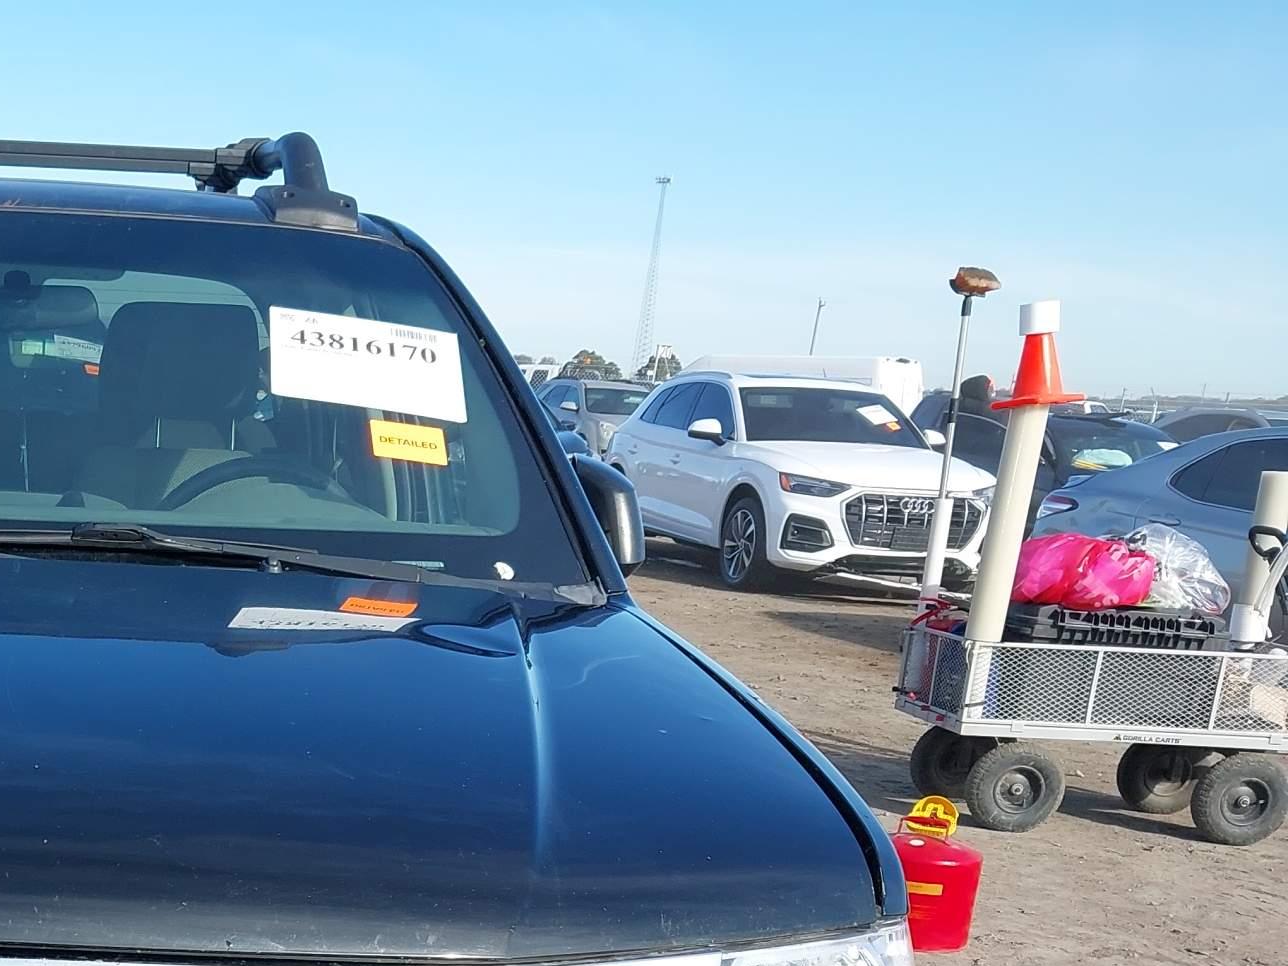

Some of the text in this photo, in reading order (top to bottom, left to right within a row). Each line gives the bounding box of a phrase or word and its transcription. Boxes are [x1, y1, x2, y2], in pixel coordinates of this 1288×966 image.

[289, 329, 438, 365] 43816170
[378, 434, 439, 451] DETAILED
[1122, 734, 1153, 742] GORILLA
